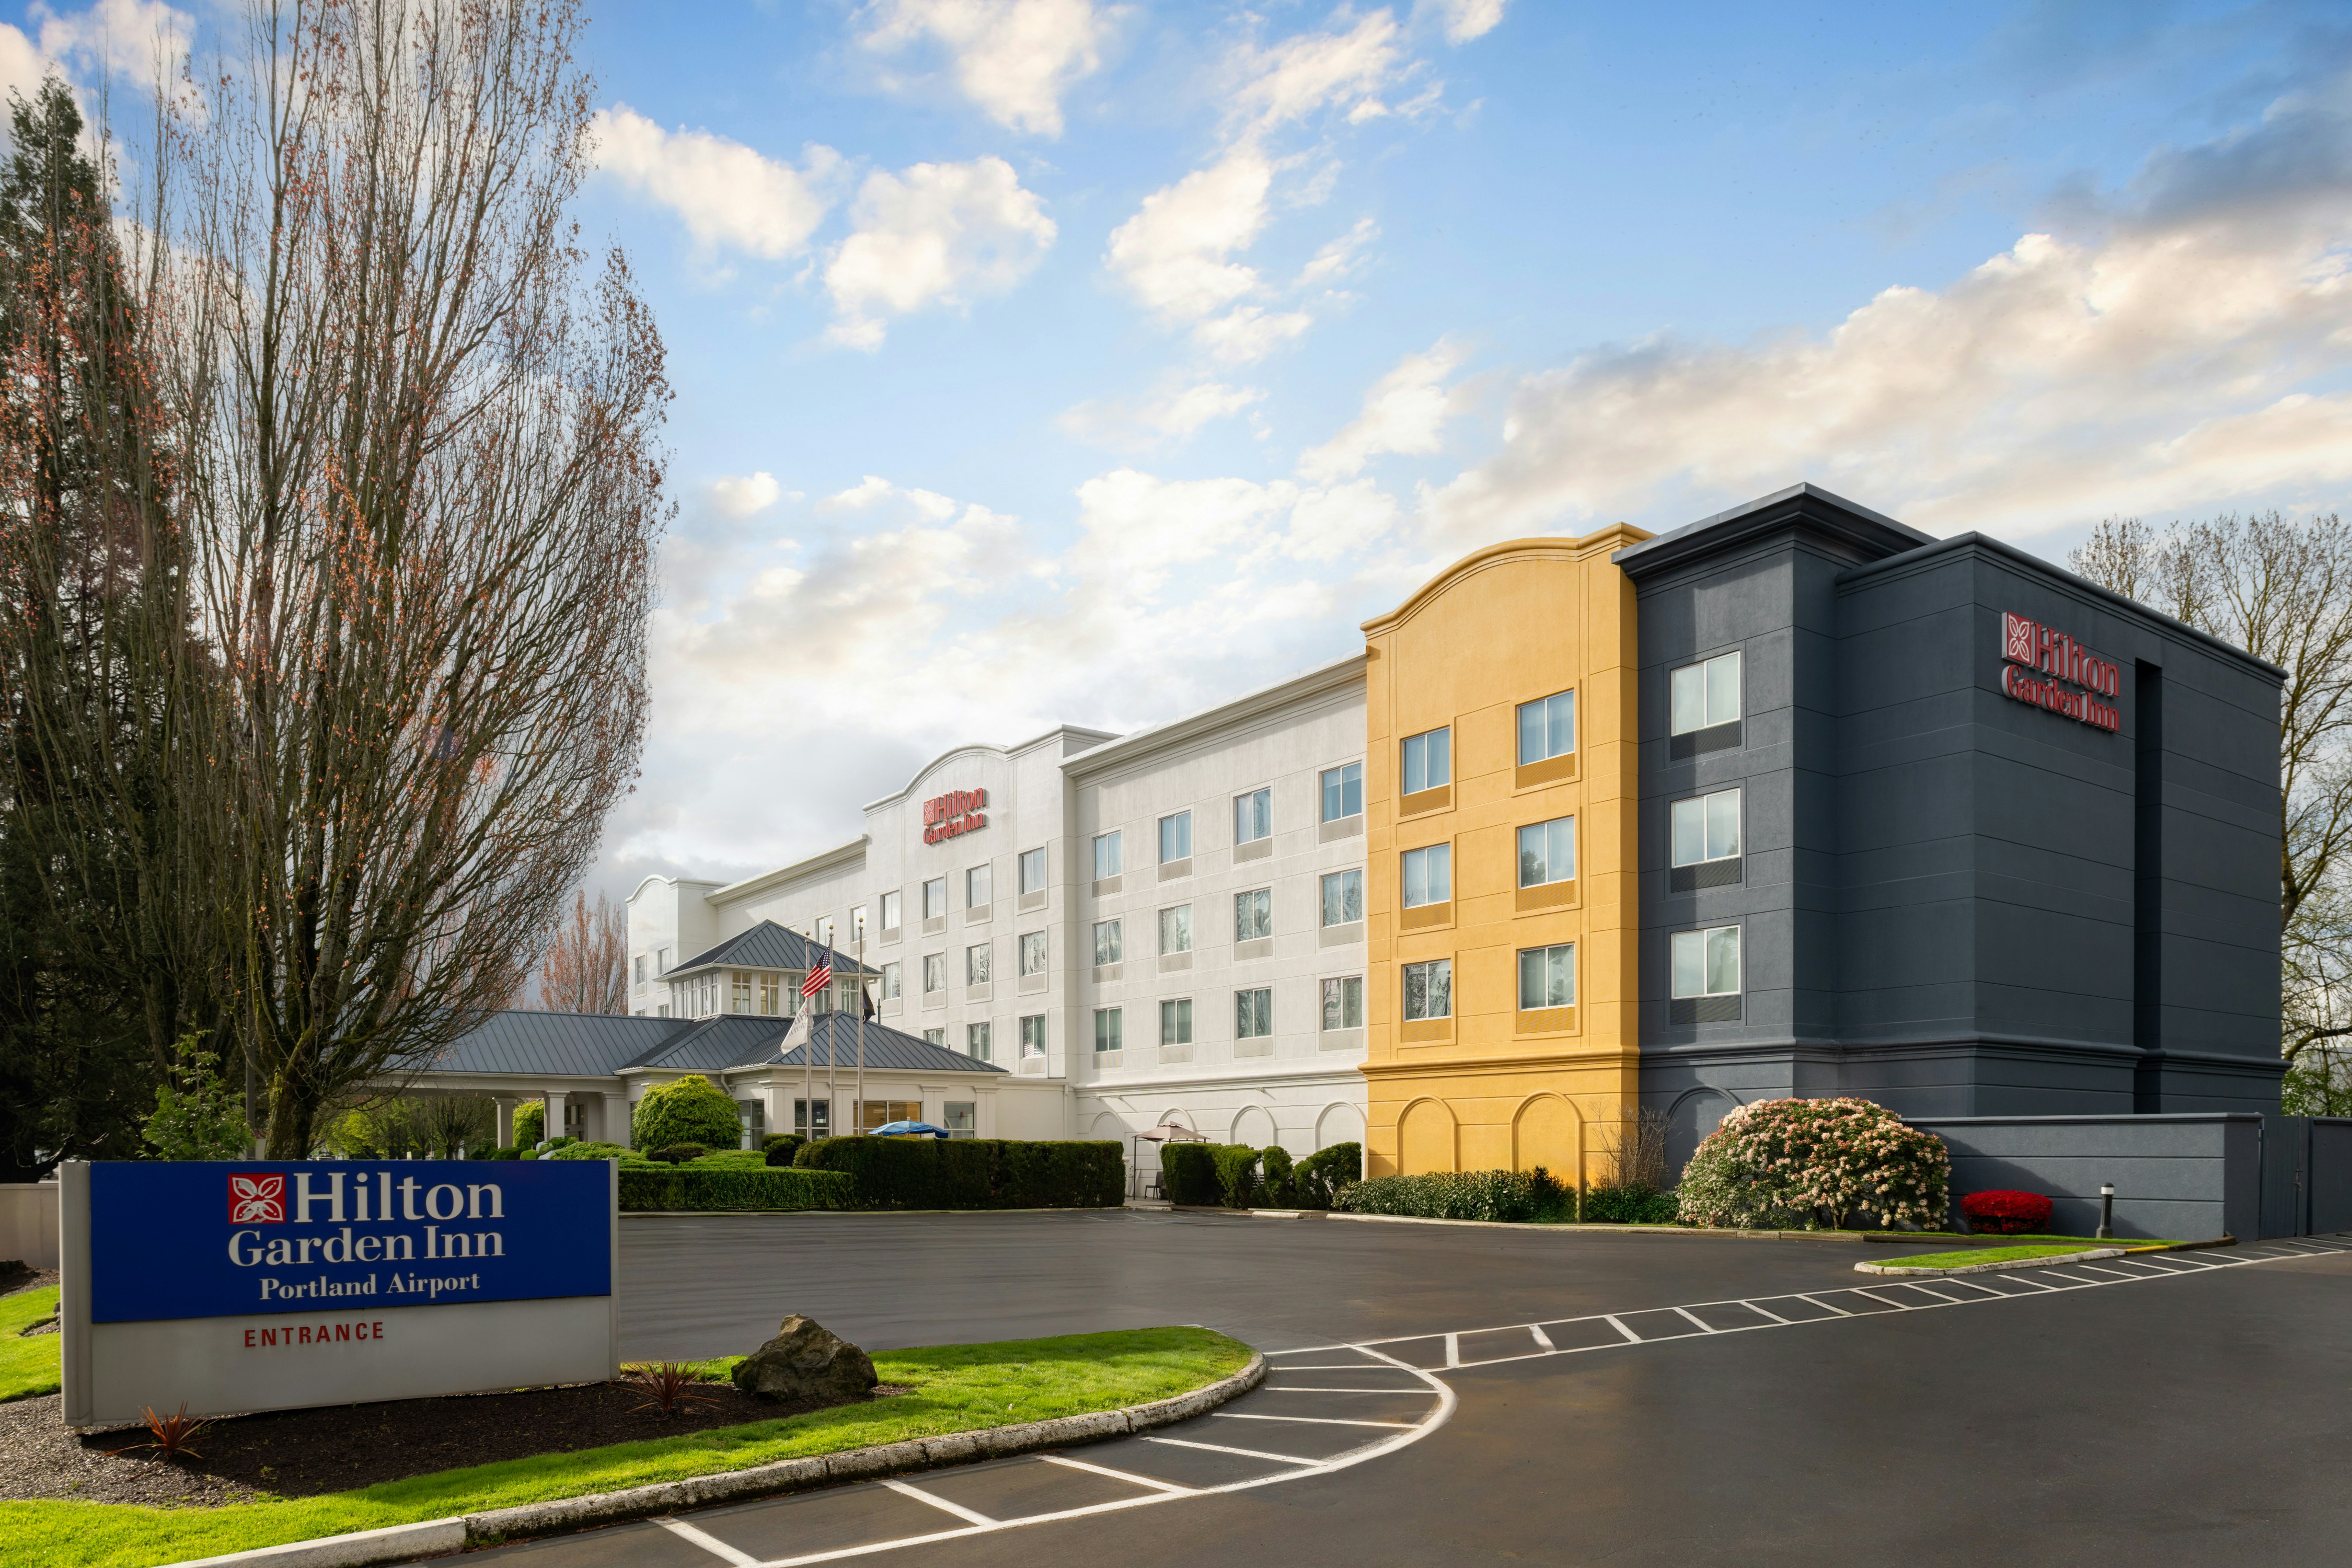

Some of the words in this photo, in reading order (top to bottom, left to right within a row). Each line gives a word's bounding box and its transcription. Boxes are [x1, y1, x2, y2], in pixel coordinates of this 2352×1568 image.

[2033, 621, 2120, 697] Hilton
[2005, 664, 2084, 720] Garden
[2085, 690, 2120, 732] Inn
[936, 787, 984, 822] Hilton
[923, 820, 962, 845] Garden
[963, 813, 984, 832] Inn
[293, 1172, 505, 1223] Hilton
[228, 1227, 416, 1267] Garden
[423, 1225, 505, 1259] Inn
[259, 1273, 377, 1300] Portland
[386, 1272, 480, 1299] Airport
[244, 1322, 384, 1348] ENTRANCE
